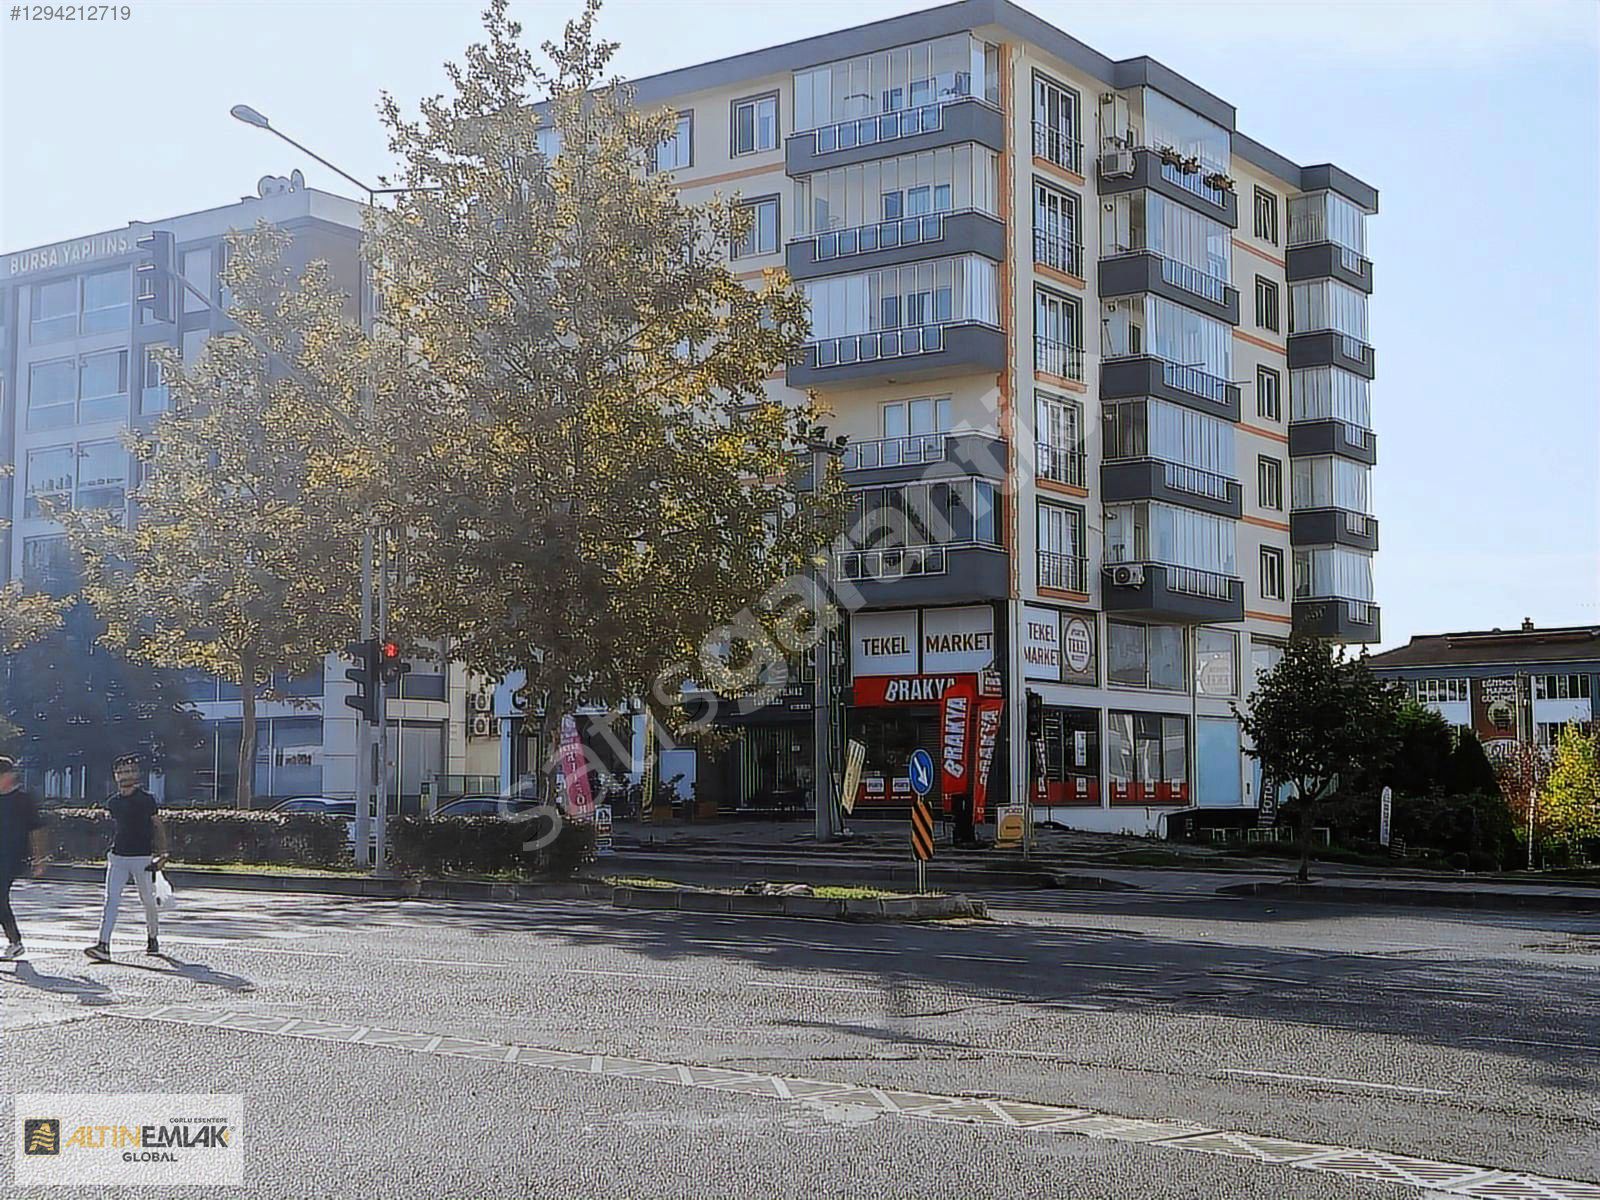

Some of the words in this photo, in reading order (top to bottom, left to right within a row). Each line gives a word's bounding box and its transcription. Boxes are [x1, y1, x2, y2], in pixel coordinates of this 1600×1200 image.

[10, 248, 58, 275] BURSA
[62, 238, 96, 263] YAPI
[862, 636, 911, 656] TEKEL
[926, 632, 993, 653] MARKET
[1028, 622, 1057, 643] TEKEL
[1024, 646, 1061, 666] MARKET
[943, 697, 968, 779] BRAKYA
